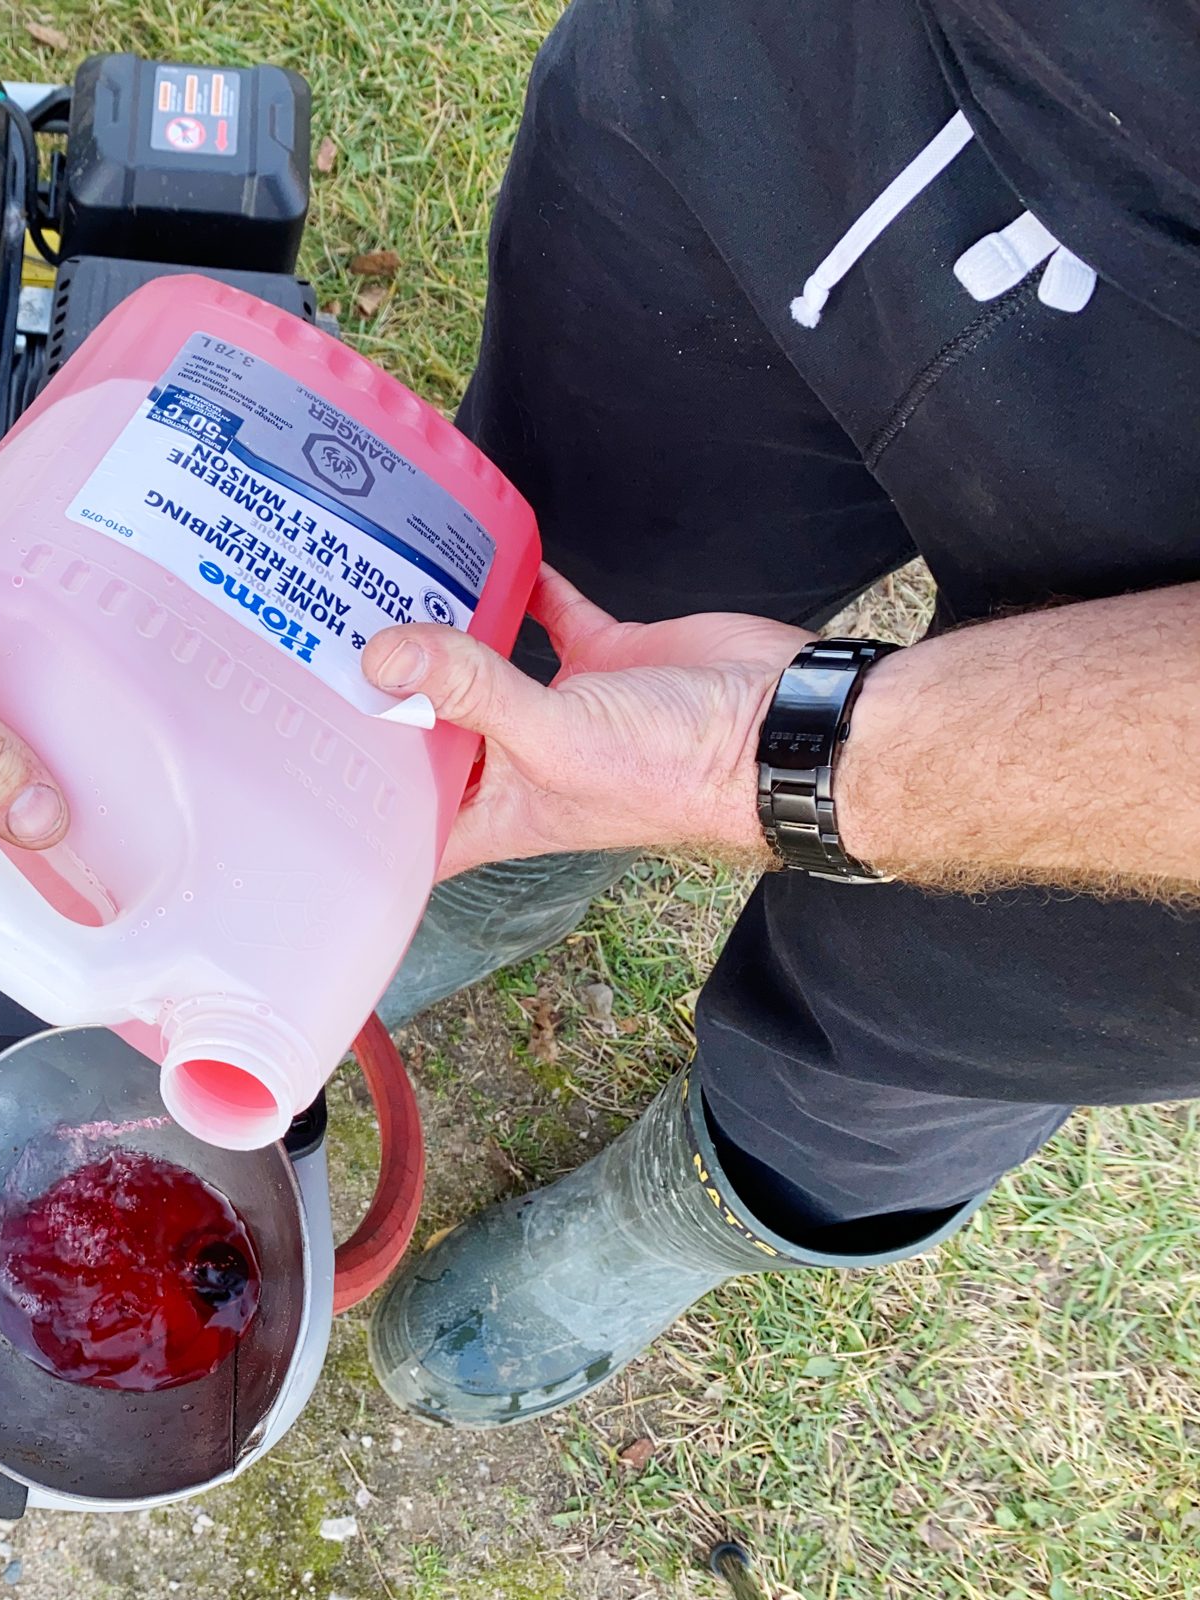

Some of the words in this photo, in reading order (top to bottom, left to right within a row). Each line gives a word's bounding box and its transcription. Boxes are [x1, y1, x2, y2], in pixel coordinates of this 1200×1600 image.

[197, 335, 212, 348] L
[213, 341, 255, 369] 3.78
[208, 368, 229, 382] Sans
[215, 362, 231, 373] pas
[230, 371, 242, 380] Ne
[201, 380, 240, 404] conduites
[151, 412, 162, 420] TO
[239, 401, 253, 411] les
[252, 407, 284, 431] Protège
[256, 404, 267, 414] de
[267, 410, 293, 429] contre
[295, 385, 359, 431] INFLAMMABLE
[161, 416, 201, 438] PROTECTION
[306, 402, 397, 473] DANGER
[200, 435, 222, 450] BURST
[362, 431, 416, 474] FLAMMABLE
[190, 442, 286, 512] MAISON
[165, 446, 300, 542] PLOMBERIE
[79, 506, 135, 539] 6310-075
[286, 506, 317, 534] ET
[404, 517, 436, 545] systems
[143, 488, 272, 582] PLUMBING
[249, 516, 304, 560] TOXIQUE
[317, 528, 353, 561] VR
[464, 541, 477, 556] not
[300, 536, 335, 567] DE
[434, 543, 455, 564] water
[439, 538, 465, 564] serious
[475, 554, 485, 566] Do
[215, 514, 351, 619] ANTIFREEZE
[304, 556, 335, 582] NON
[453, 562, 478, 587] Protect
[233, 566, 305, 621] NON-TOXIC
[335, 561, 416, 630] NTIGEL
[351, 554, 414, 610] POUR
[194, 557, 323, 663] Home
[272, 576, 346, 636] HOME
[347, 629, 367, 651] &
